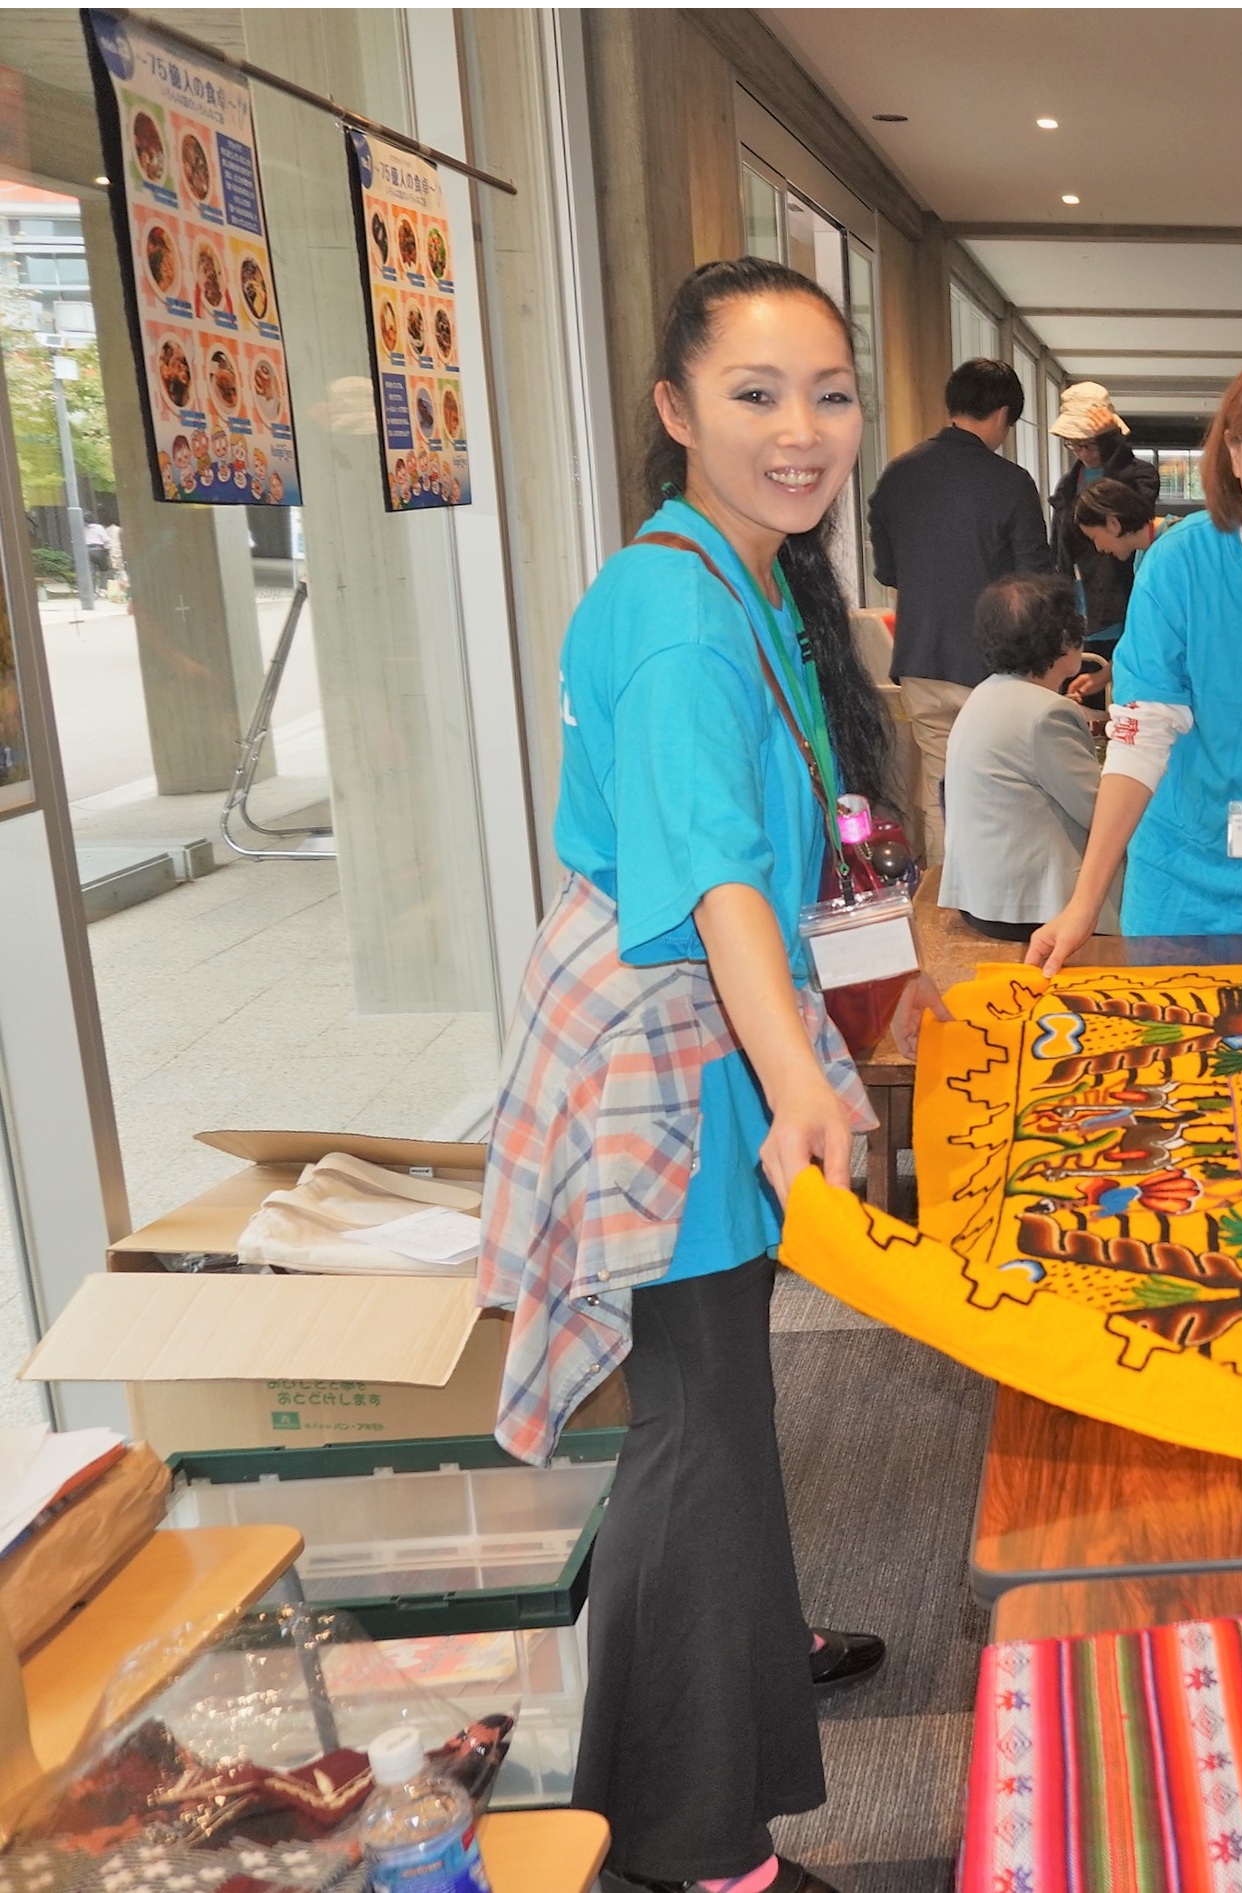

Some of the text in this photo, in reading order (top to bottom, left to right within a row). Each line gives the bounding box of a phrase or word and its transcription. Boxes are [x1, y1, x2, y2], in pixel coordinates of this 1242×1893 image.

[277, 1391, 382, 1407] おとどけします
